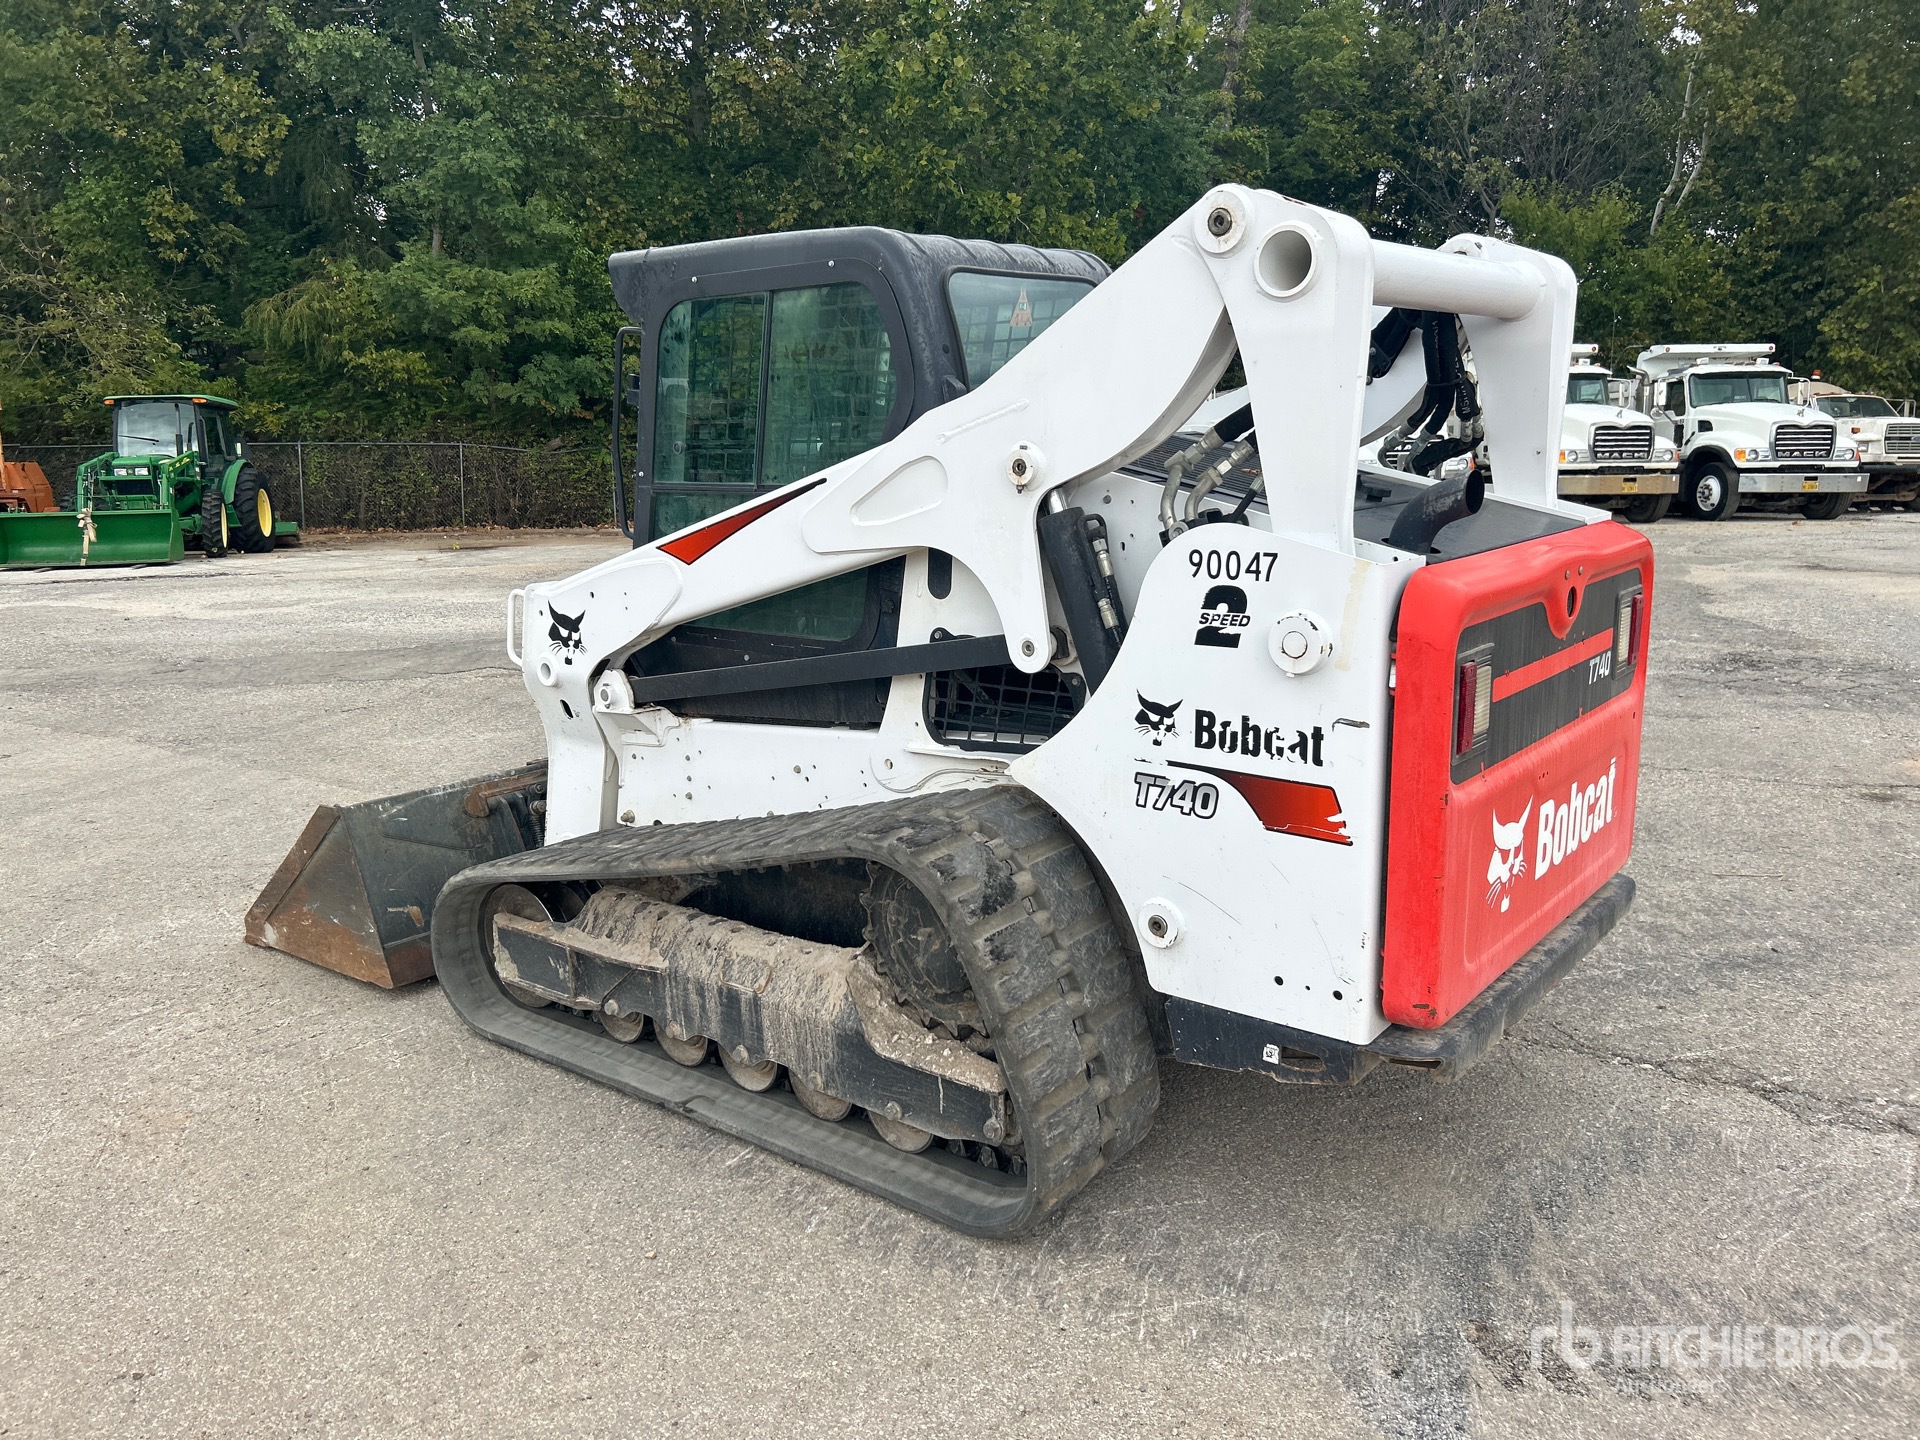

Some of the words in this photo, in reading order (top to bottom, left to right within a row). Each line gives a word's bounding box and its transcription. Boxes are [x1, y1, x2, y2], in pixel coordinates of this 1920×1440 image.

[1777, 450, 1827, 458] MACK
[1188, 549, 1278, 582] 90047
[1194, 584, 1248, 649] 2
[1198, 612, 1251, 628] SPEED
[1588, 650, 1612, 685] T740
[1194, 708, 1325, 767] Bobcat
[1134, 771, 1219, 819] T740
[1535, 756, 1617, 881] Bobcat
